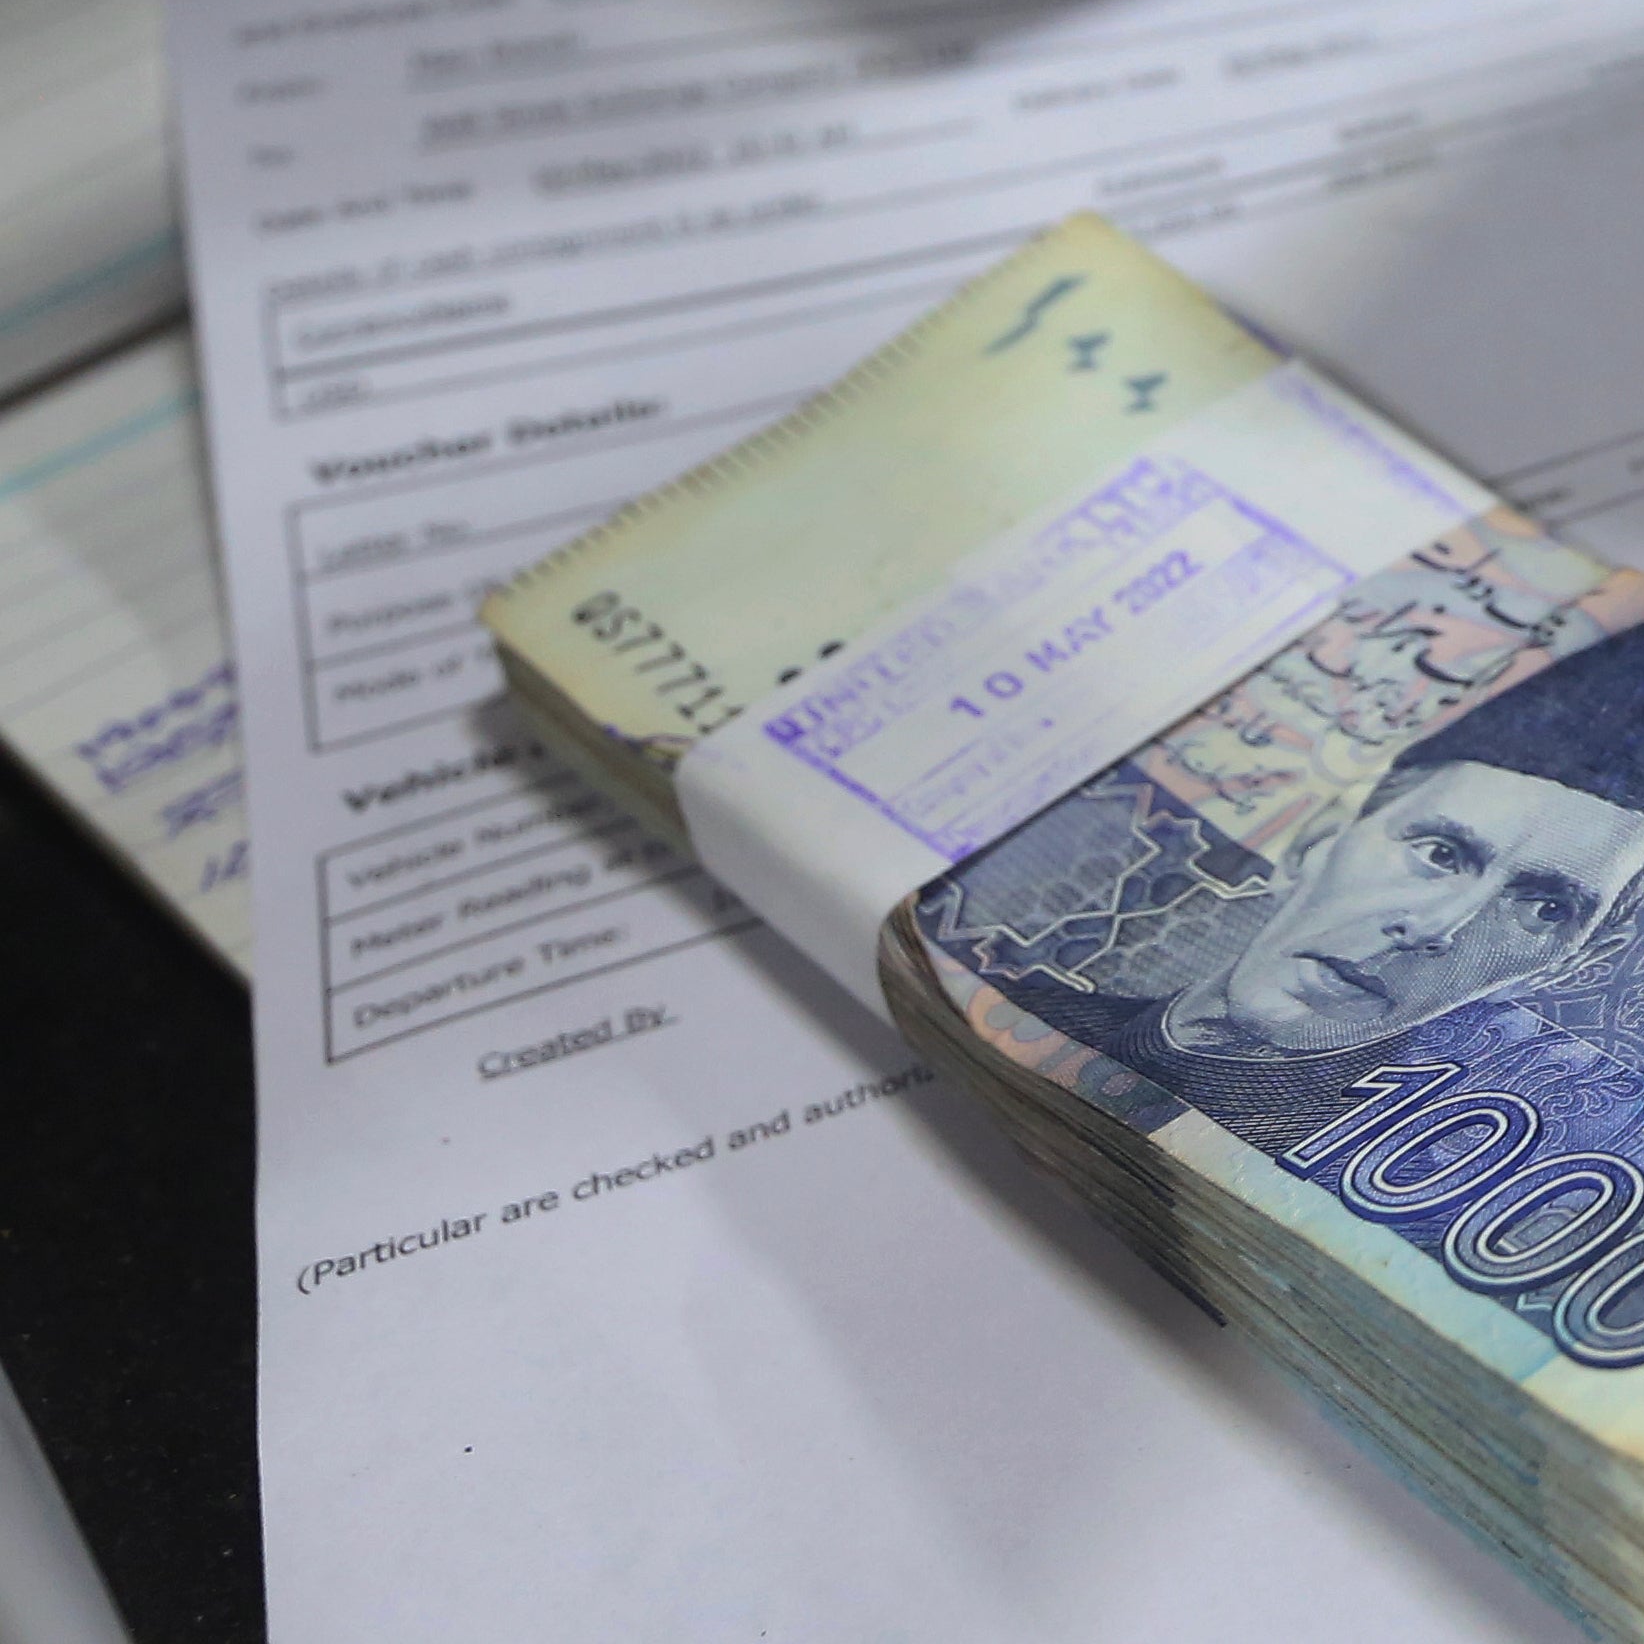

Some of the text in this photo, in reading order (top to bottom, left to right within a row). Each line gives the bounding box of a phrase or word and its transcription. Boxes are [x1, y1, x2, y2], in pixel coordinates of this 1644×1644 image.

[310, 428, 494, 485] Voucher
[1025, 606, 1114, 673] MAY
[1112, 550, 1205, 616] 2022
[343, 762, 463, 815] Vehicle
[347, 841, 463, 888] Vehicle
[350, 865, 593, 958] Meter Reading
[352, 959, 525, 1029] Departure
[476, 1020, 613, 1083] Created
[298, 1211, 485, 1296] (Particular
[500, 1189, 561, 1225] are
[572, 1137, 716, 1203] checked
[727, 1109, 792, 1152] and
